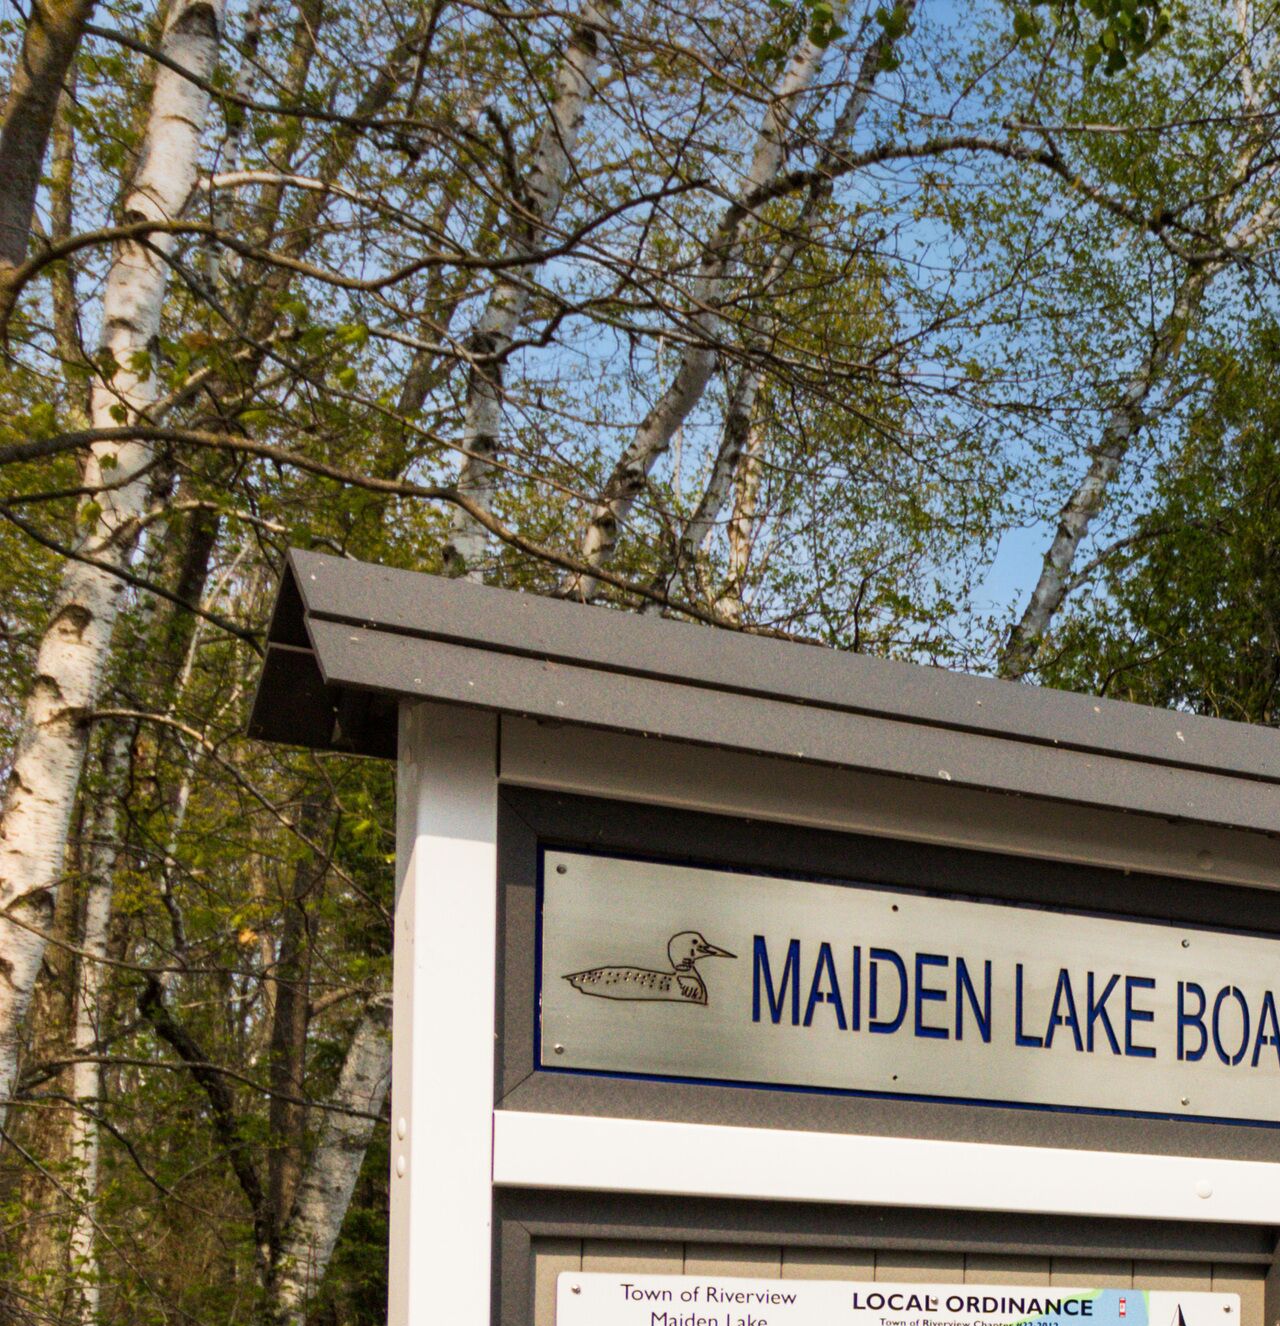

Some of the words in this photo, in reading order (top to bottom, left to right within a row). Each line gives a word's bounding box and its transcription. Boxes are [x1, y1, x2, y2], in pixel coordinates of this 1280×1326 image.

[752, 935, 991, 1042] MAIDEN
[1015, 964, 1156, 1057] LAKE
[620, 1283, 672, 1301] Town
[680, 1286, 700, 1303] of
[706, 1286, 797, 1305] Riverview
[853, 1292, 939, 1312] LOCAL
[945, 1295, 1093, 1316] ORDINANCE
[879, 1317, 907, 1326] Town
[909, 1319, 920, 1326] of
